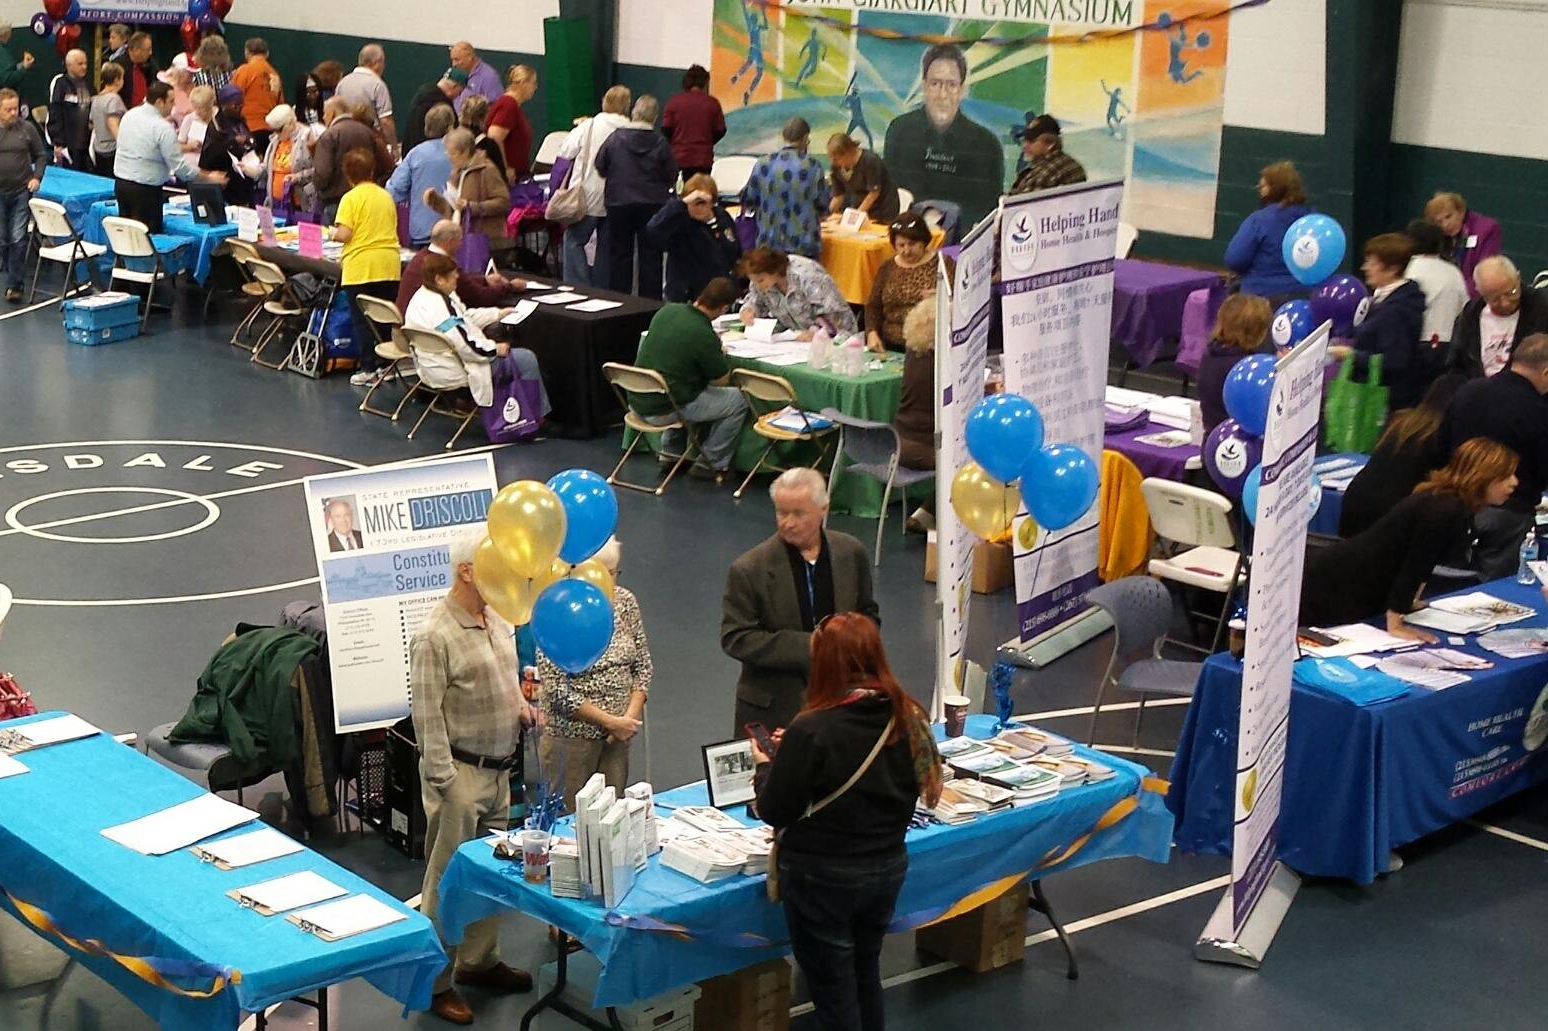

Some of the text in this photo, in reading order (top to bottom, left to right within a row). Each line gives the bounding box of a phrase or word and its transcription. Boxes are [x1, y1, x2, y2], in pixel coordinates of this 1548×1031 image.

[1040, 202, 1120, 235] Helping Hand
[1040, 238, 1060, 250] Home
[1062, 232, 1084, 245] Health
[361, 481, 470, 501] STATE REPRESENTATIVE
[363, 491, 490, 534] MIKE DRISCOLL
[393, 552, 450, 572] Constitu
[395, 571, 447, 591] Service
[408, 598, 426, 606] OFFICE
[1468, 707, 1524, 733] HOME HEALTH
[525, 851, 547, 866] Wa
